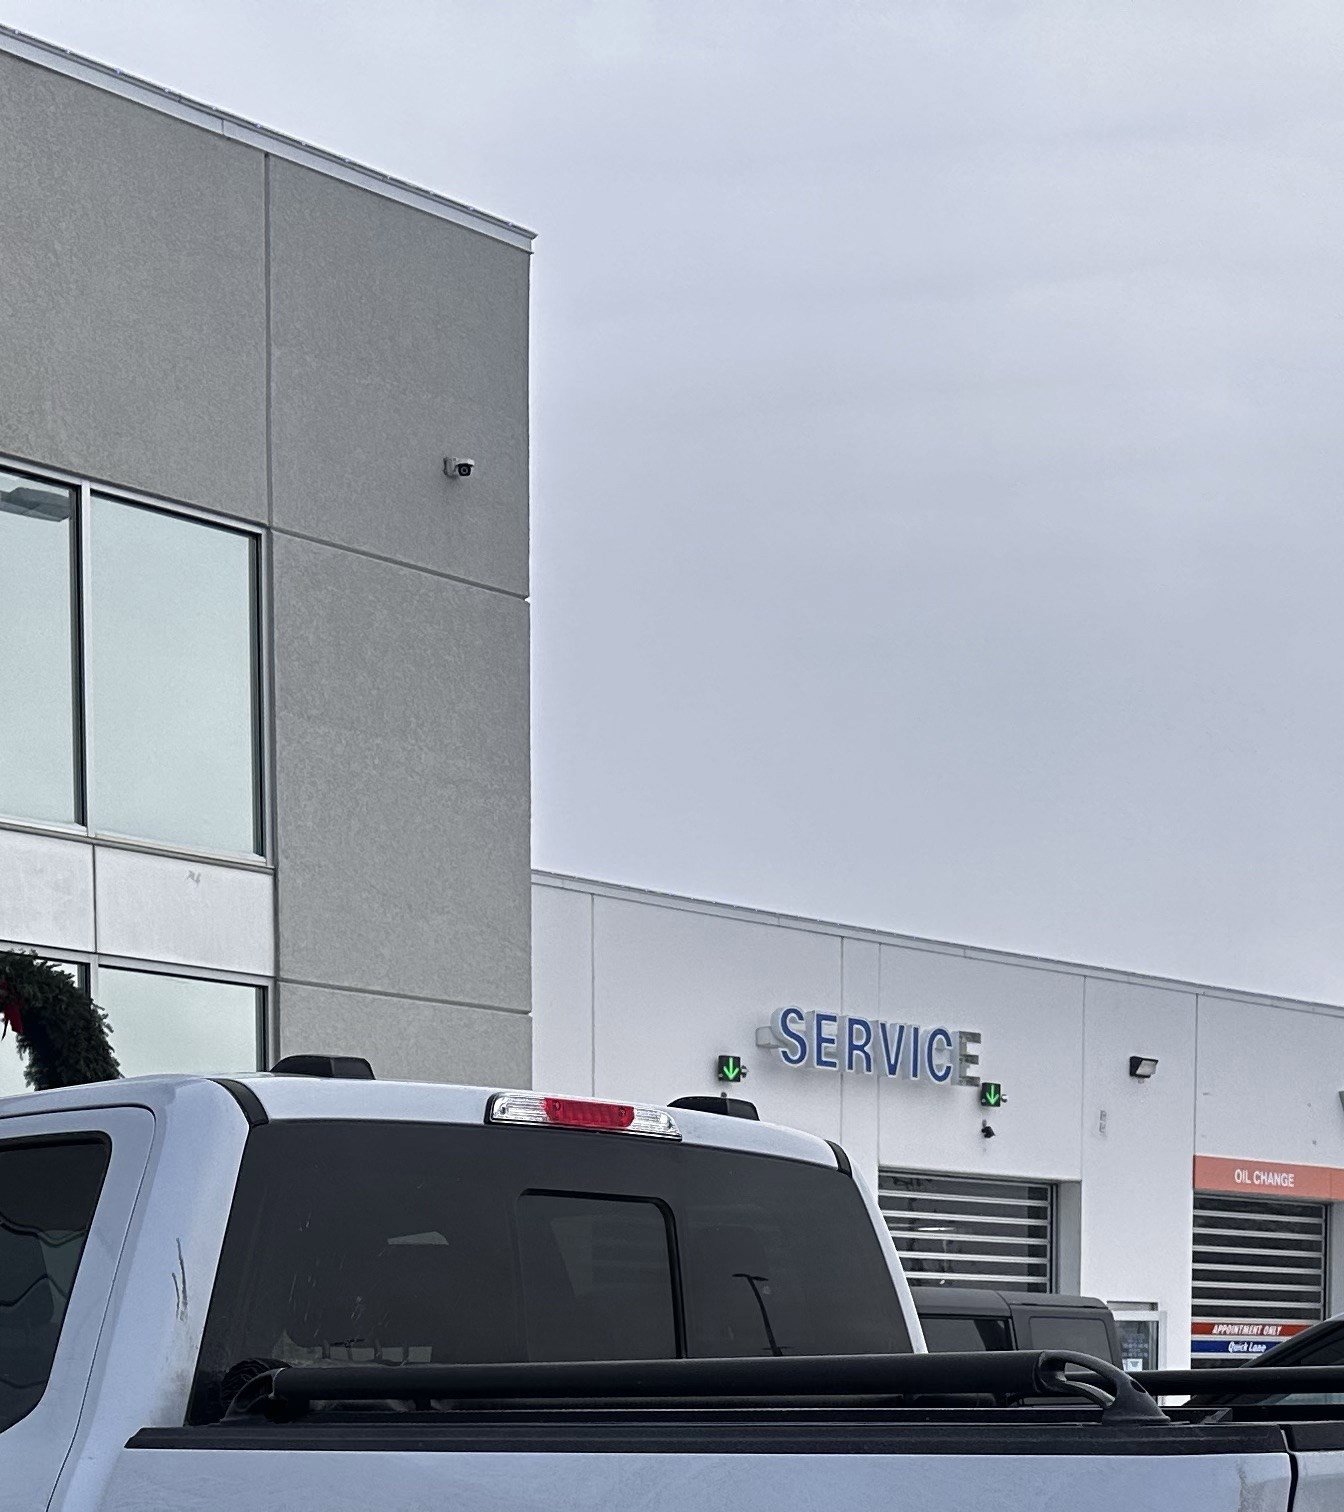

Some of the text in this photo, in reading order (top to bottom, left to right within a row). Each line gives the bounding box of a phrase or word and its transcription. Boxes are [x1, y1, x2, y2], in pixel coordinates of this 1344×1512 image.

[776, 1006, 982, 1088] SERVICE
[1234, 1168, 1295, 1188] OIL CHANGE
[1211, 1324, 1283, 1336] APPOINTMENT ONLY
[1228, 1341, 1267, 1353] Quick Lane
